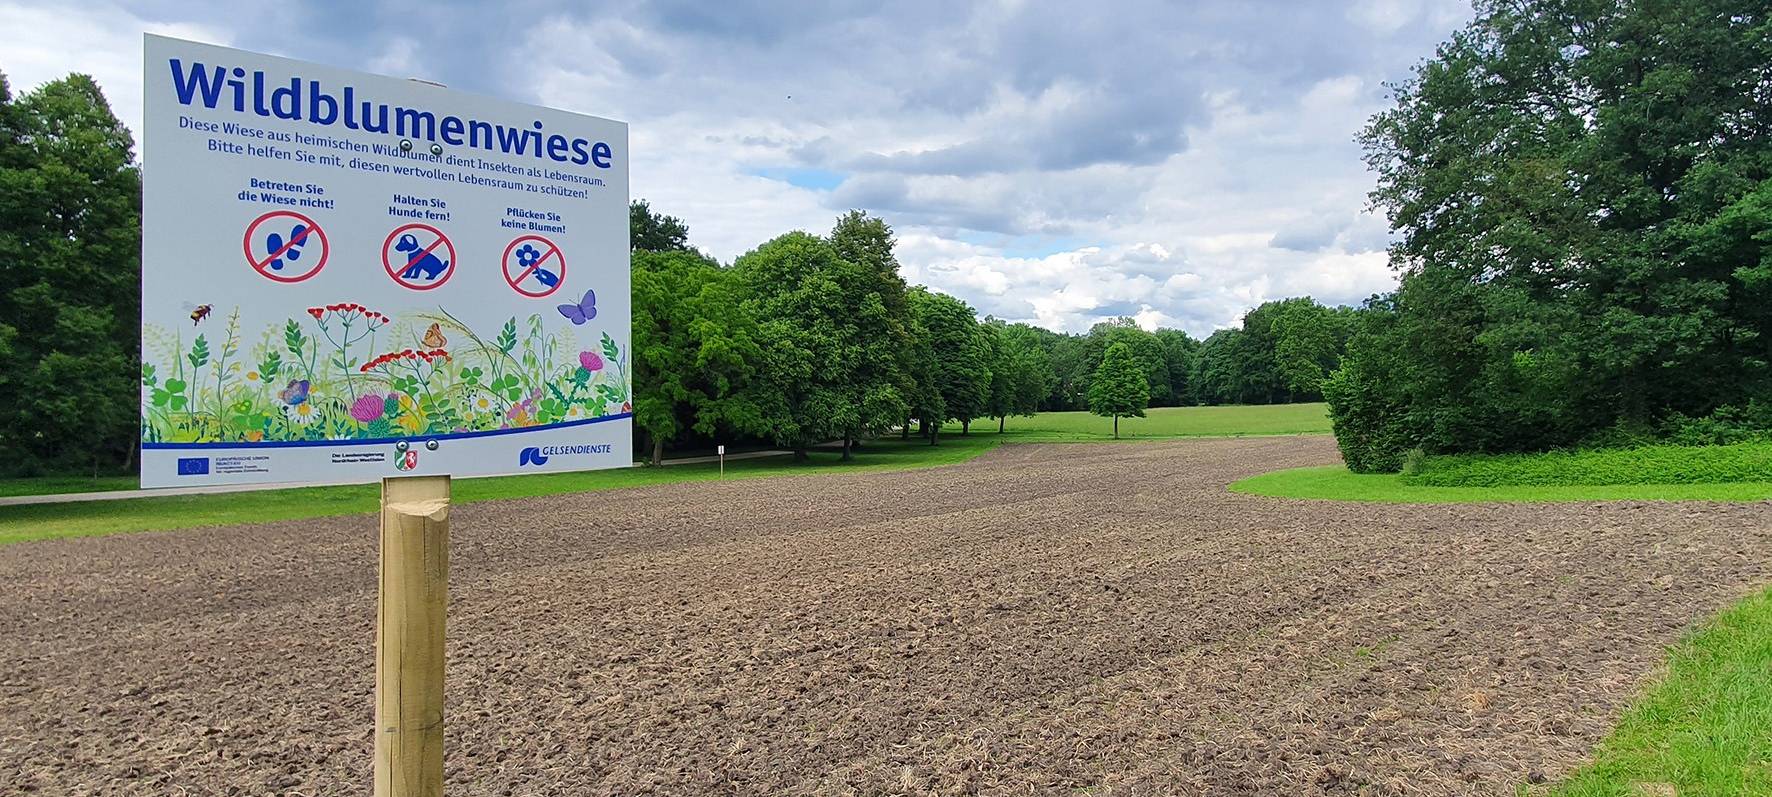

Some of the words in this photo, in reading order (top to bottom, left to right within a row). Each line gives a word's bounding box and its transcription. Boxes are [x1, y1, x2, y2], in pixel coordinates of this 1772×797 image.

[169, 58, 612, 169] Wildblumenwiese
[179, 116, 219, 132] Diese
[223, 122, 264, 139] Wiese
[267, 130, 291, 142] aus
[295, 132, 369, 153] heimischen
[372, 143, 442, 163] Wildblumen
[446, 154, 475, 169] dient
[478, 159, 525, 176] Insekten
[527, 164, 542, 178] als
[544, 169, 606, 187] Lebensraum.
[208, 139, 243, 155] Bitte
[247, 144, 291, 160] helfen
[295, 150, 316, 164] Sie
[319, 155, 345, 168] mit,
[349, 158, 390, 174] diesen
[393, 165, 455, 182] wertvollen
[458, 172, 524, 191] Lebensraum
[526, 183, 538, 193] zu
[541, 184, 588, 200] schützen!
[250, 178, 303, 193] Betreten
[306, 184, 324, 195] Sie
[238, 190, 257, 202] die
[261, 193, 297, 206] Wiese
[300, 197, 334, 209] nicht!
[393, 194, 428, 207] Halten
[431, 198, 446, 209] Sie
[388, 206, 423, 219] Hunde
[425, 210, 450, 221] fern!
[506, 207, 545, 220] Pflücken
[547, 212, 561, 222] Sie
[501, 219, 527, 230] keine
[529, 222, 566, 234] Blumen!
[542, 444, 612, 456] GELSENDIENSTE
